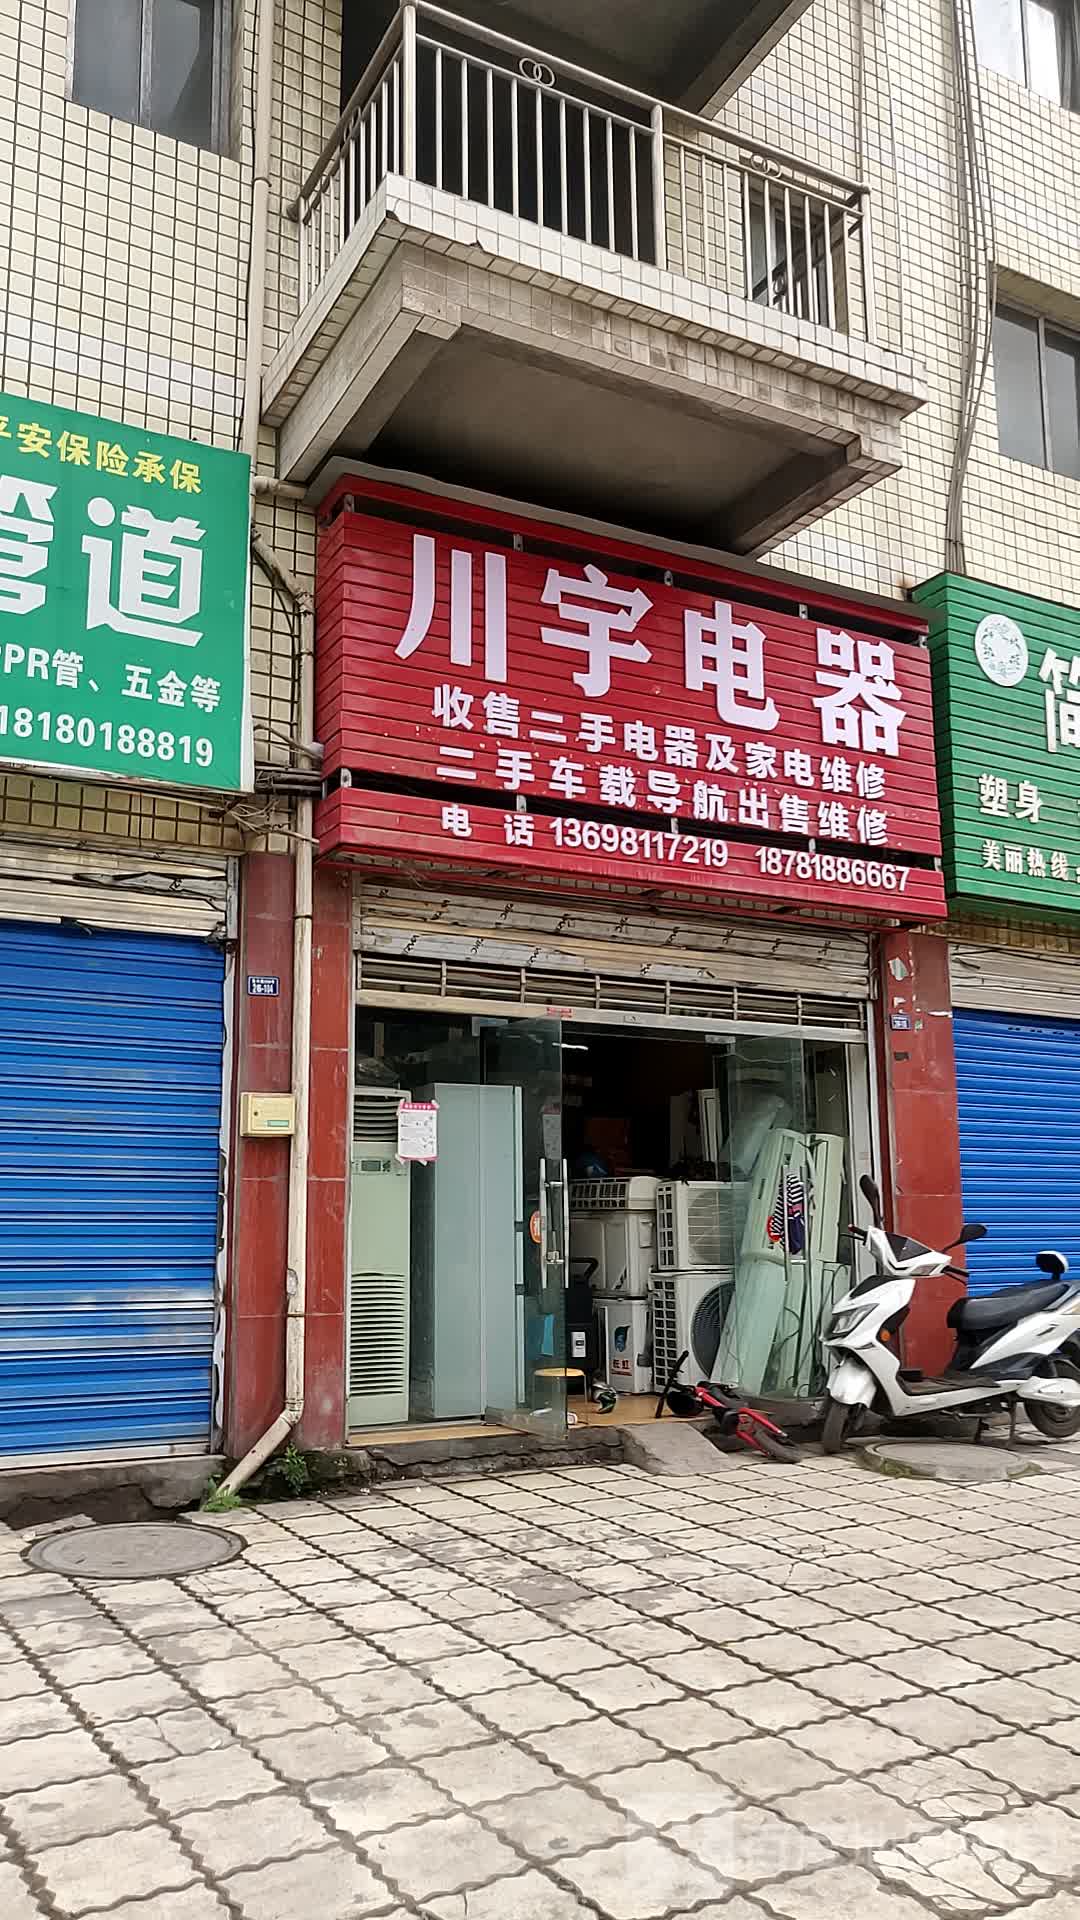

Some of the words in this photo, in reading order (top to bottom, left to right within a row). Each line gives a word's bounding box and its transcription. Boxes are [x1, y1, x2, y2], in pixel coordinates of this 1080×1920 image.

[0, 642, 222, 713] PR管、五金等
[394, 533, 907, 757] 川宇电器
[0, 704, 214, 767] 18180188819
[431, 683, 886, 800] 收售二手电器及家电维修
[436, 746, 889, 847] 二手车载导航出售维修
[978, 772, 1044, 823] 塑身
[549, 816, 729, 868] 13698117219
[755, 846, 912, 893] 18781886667
